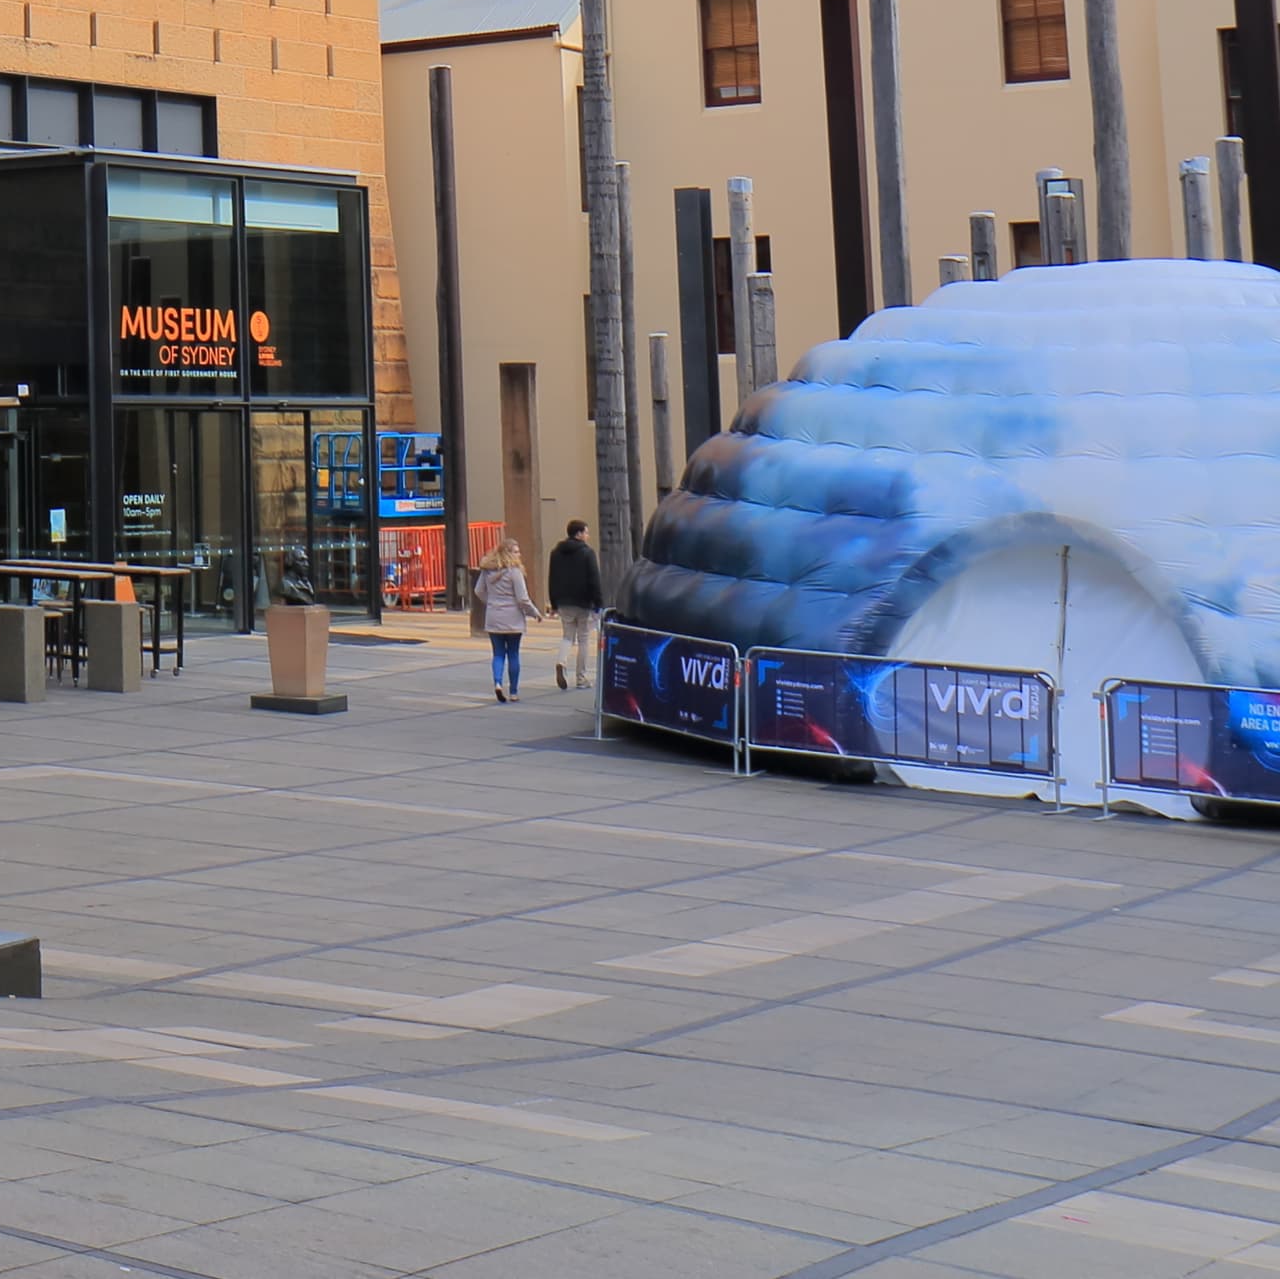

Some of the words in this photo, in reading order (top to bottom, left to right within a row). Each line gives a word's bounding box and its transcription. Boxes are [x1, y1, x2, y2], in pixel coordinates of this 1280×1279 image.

[120, 304, 237, 343] MUSEUM
[159, 345, 179, 365] OF
[181, 345, 236, 366] SYDNEY
[164, 369, 180, 377] FIRST
[182, 370, 218, 378] GOVERNMENT
[123, 494, 144, 505] OPEN
[144, 493, 166, 505] DAILY
[1249, 703, 1265, 716] NO
[1240, 716, 1270, 731] AREA
